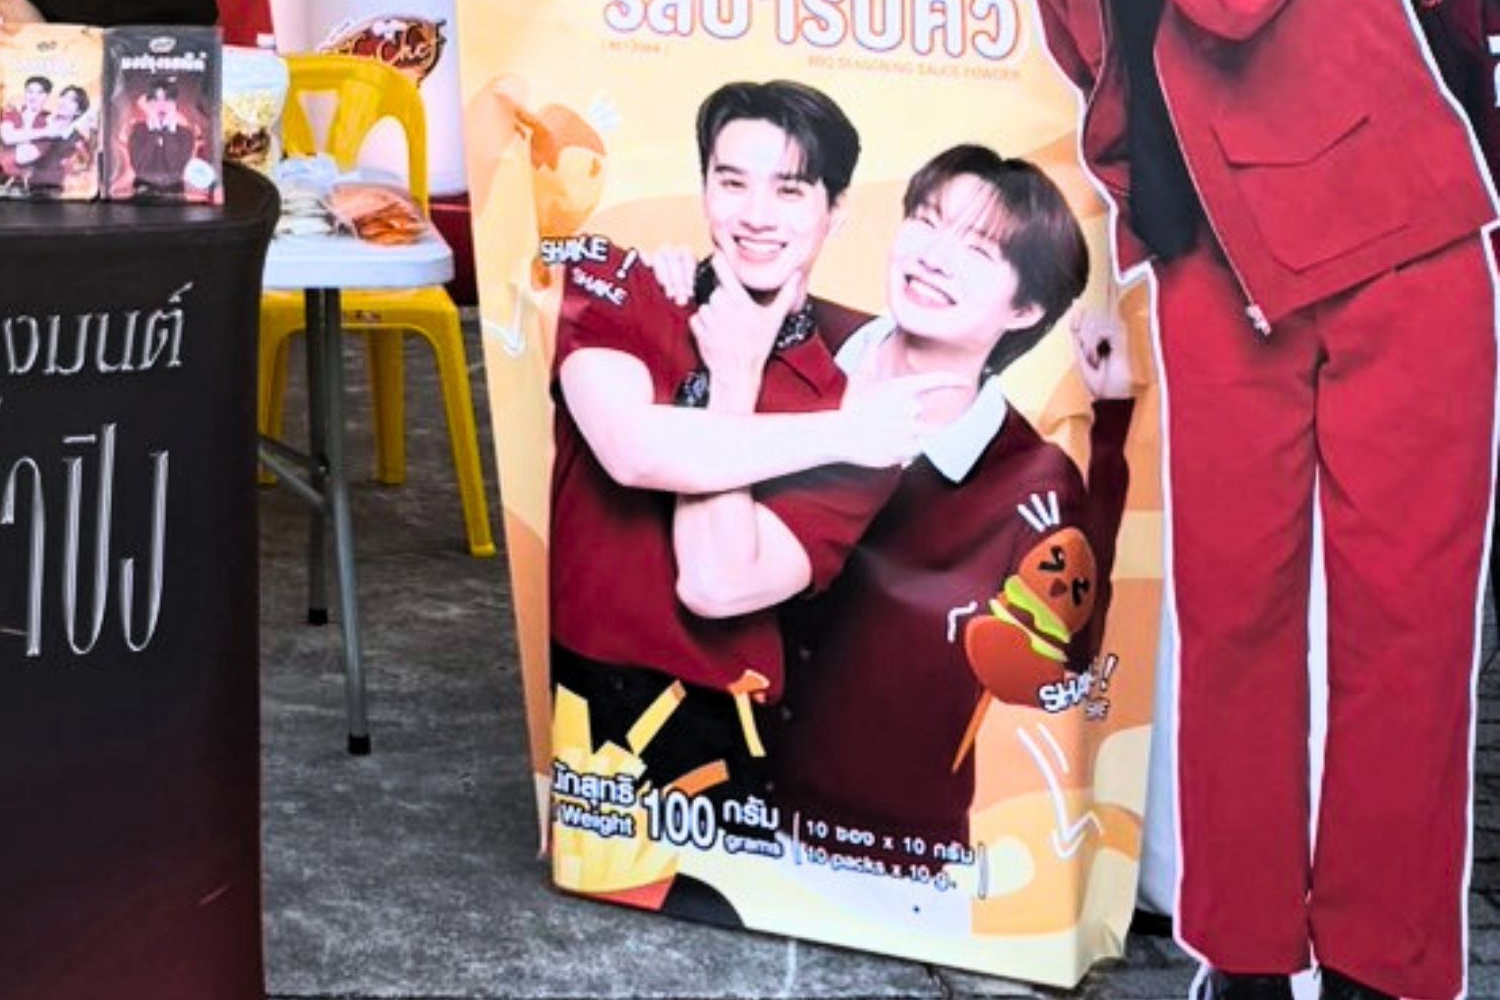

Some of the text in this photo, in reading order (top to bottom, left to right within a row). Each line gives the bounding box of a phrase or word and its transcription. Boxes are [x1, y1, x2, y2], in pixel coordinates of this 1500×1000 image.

[541, 236, 608, 263] SHAKE
[559, 804, 782, 858] Weight grams
[642, 787, 716, 850] 100
[723, 794, 779, 831] กรัม
[805, 820, 829, 839] 10
[882, 836, 895, 850] x
[903, 837, 926, 855] 10
[933, 840, 975, 864] กรัม
[806, 847, 827, 865] 10
[831, 853, 886, 876] packs
[908, 865, 931, 884] 10
